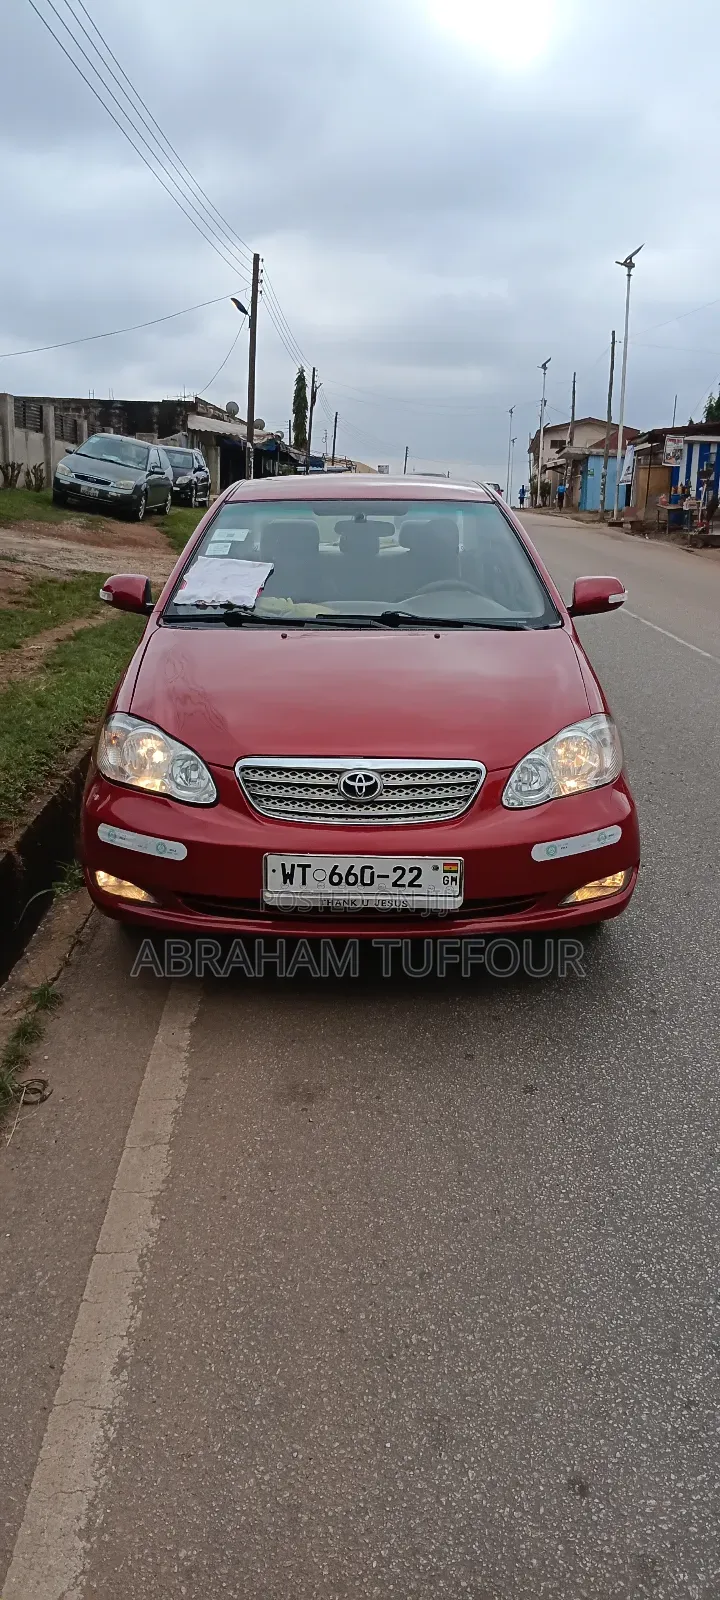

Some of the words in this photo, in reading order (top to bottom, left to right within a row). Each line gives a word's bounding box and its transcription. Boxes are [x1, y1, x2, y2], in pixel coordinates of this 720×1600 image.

[280, 862, 312, 886] WT
[328, 864, 423, 888] 660-22
[322, 899, 358, 907] THANK
[361, 899, 369, 907] U
[374, 899, 408, 907] JESUS
